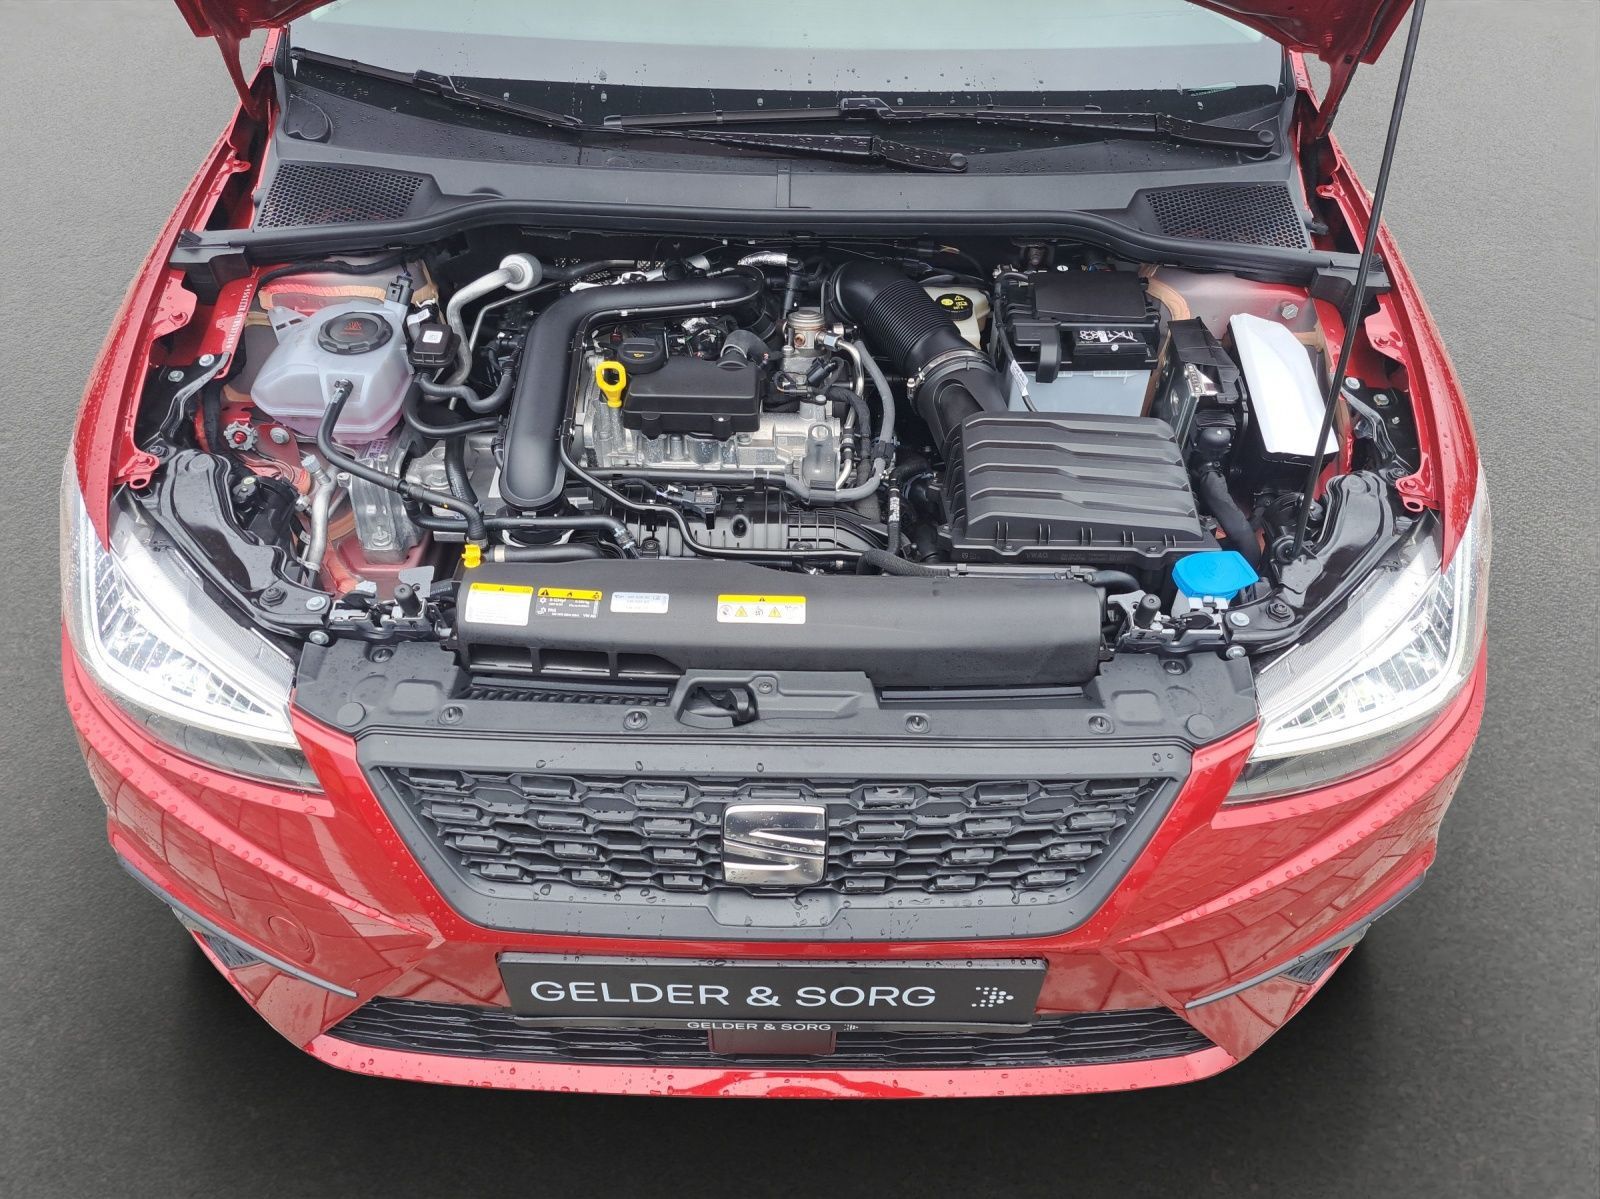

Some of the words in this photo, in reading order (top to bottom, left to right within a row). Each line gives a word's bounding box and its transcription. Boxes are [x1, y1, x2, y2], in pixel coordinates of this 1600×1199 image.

[530, 980, 730, 1006] GELDER
[746, 985, 782, 1007] &
[795, 985, 937, 1007] SORG
[687, 1021, 758, 1031] GELDER
[763, 1022, 776, 1031] &
[780, 1023, 832, 1031] SORG
